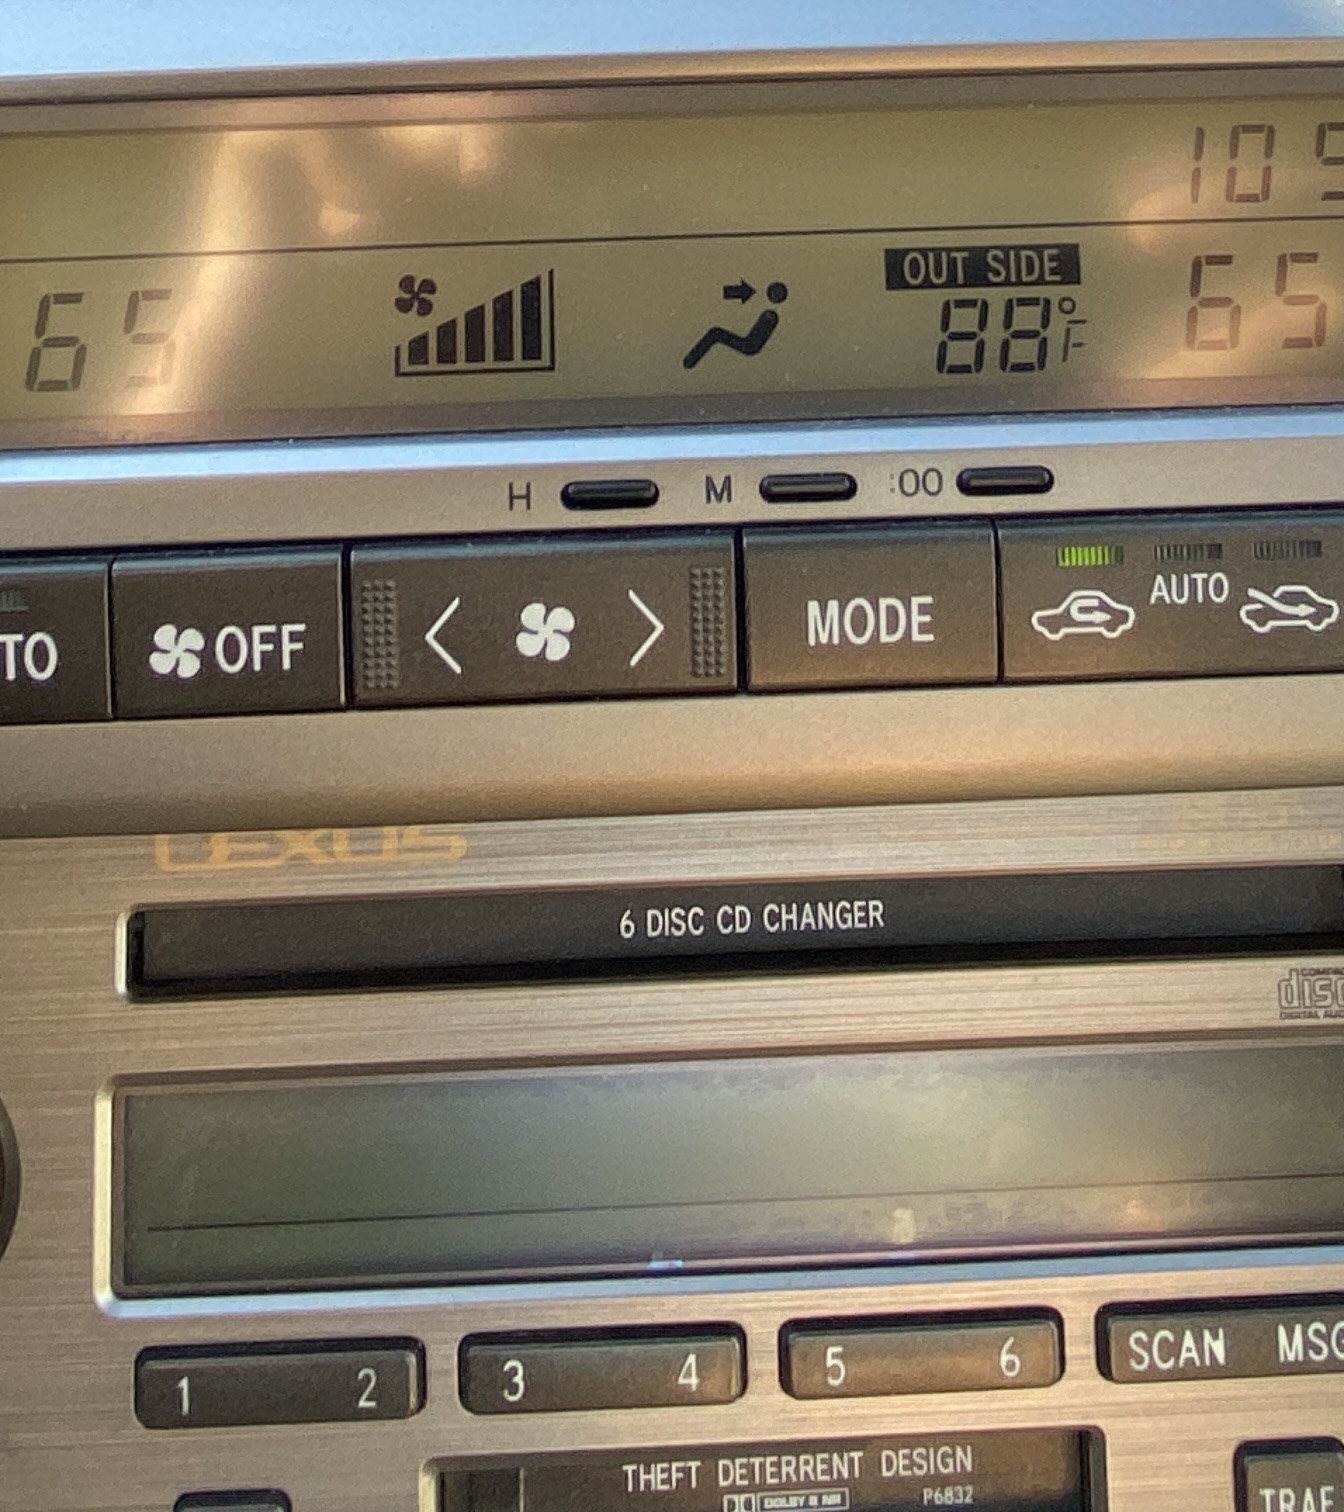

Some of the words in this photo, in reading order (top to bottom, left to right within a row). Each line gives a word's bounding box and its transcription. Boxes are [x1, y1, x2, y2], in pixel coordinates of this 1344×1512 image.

[902, 250, 970, 286] OUT
[985, 248, 1062, 284] SIDE
[1186, 252, 1327, 350] 65
[25, 288, 176, 392] 65
[508, 483, 532, 511] H
[704, 476, 733, 504] M
[1149, 572, 1230, 605] AUTO
[806, 595, 935, 647] MODE
[214, 623, 307, 674] OFF
[618, 906, 636, 940] 6
[645, 904, 705, 938] DISC
[716, 902, 752, 935] CD
[762, 899, 885, 933] CHANGER
[825, 1345, 847, 1387] 5
[999, 1336, 1022, 1379] 6
[1128, 1328, 1228, 1373] SCAN
[177, 1375, 192, 1416] 1
[357, 1367, 379, 1409] 2
[502, 1359, 525, 1403] 3
[677, 1352, 701, 1392] 4
[622, 1461, 702, 1493] THEFT
[717, 1451, 864, 1488] DETERRENT
[880, 1445, 973, 1478] DESIGN
